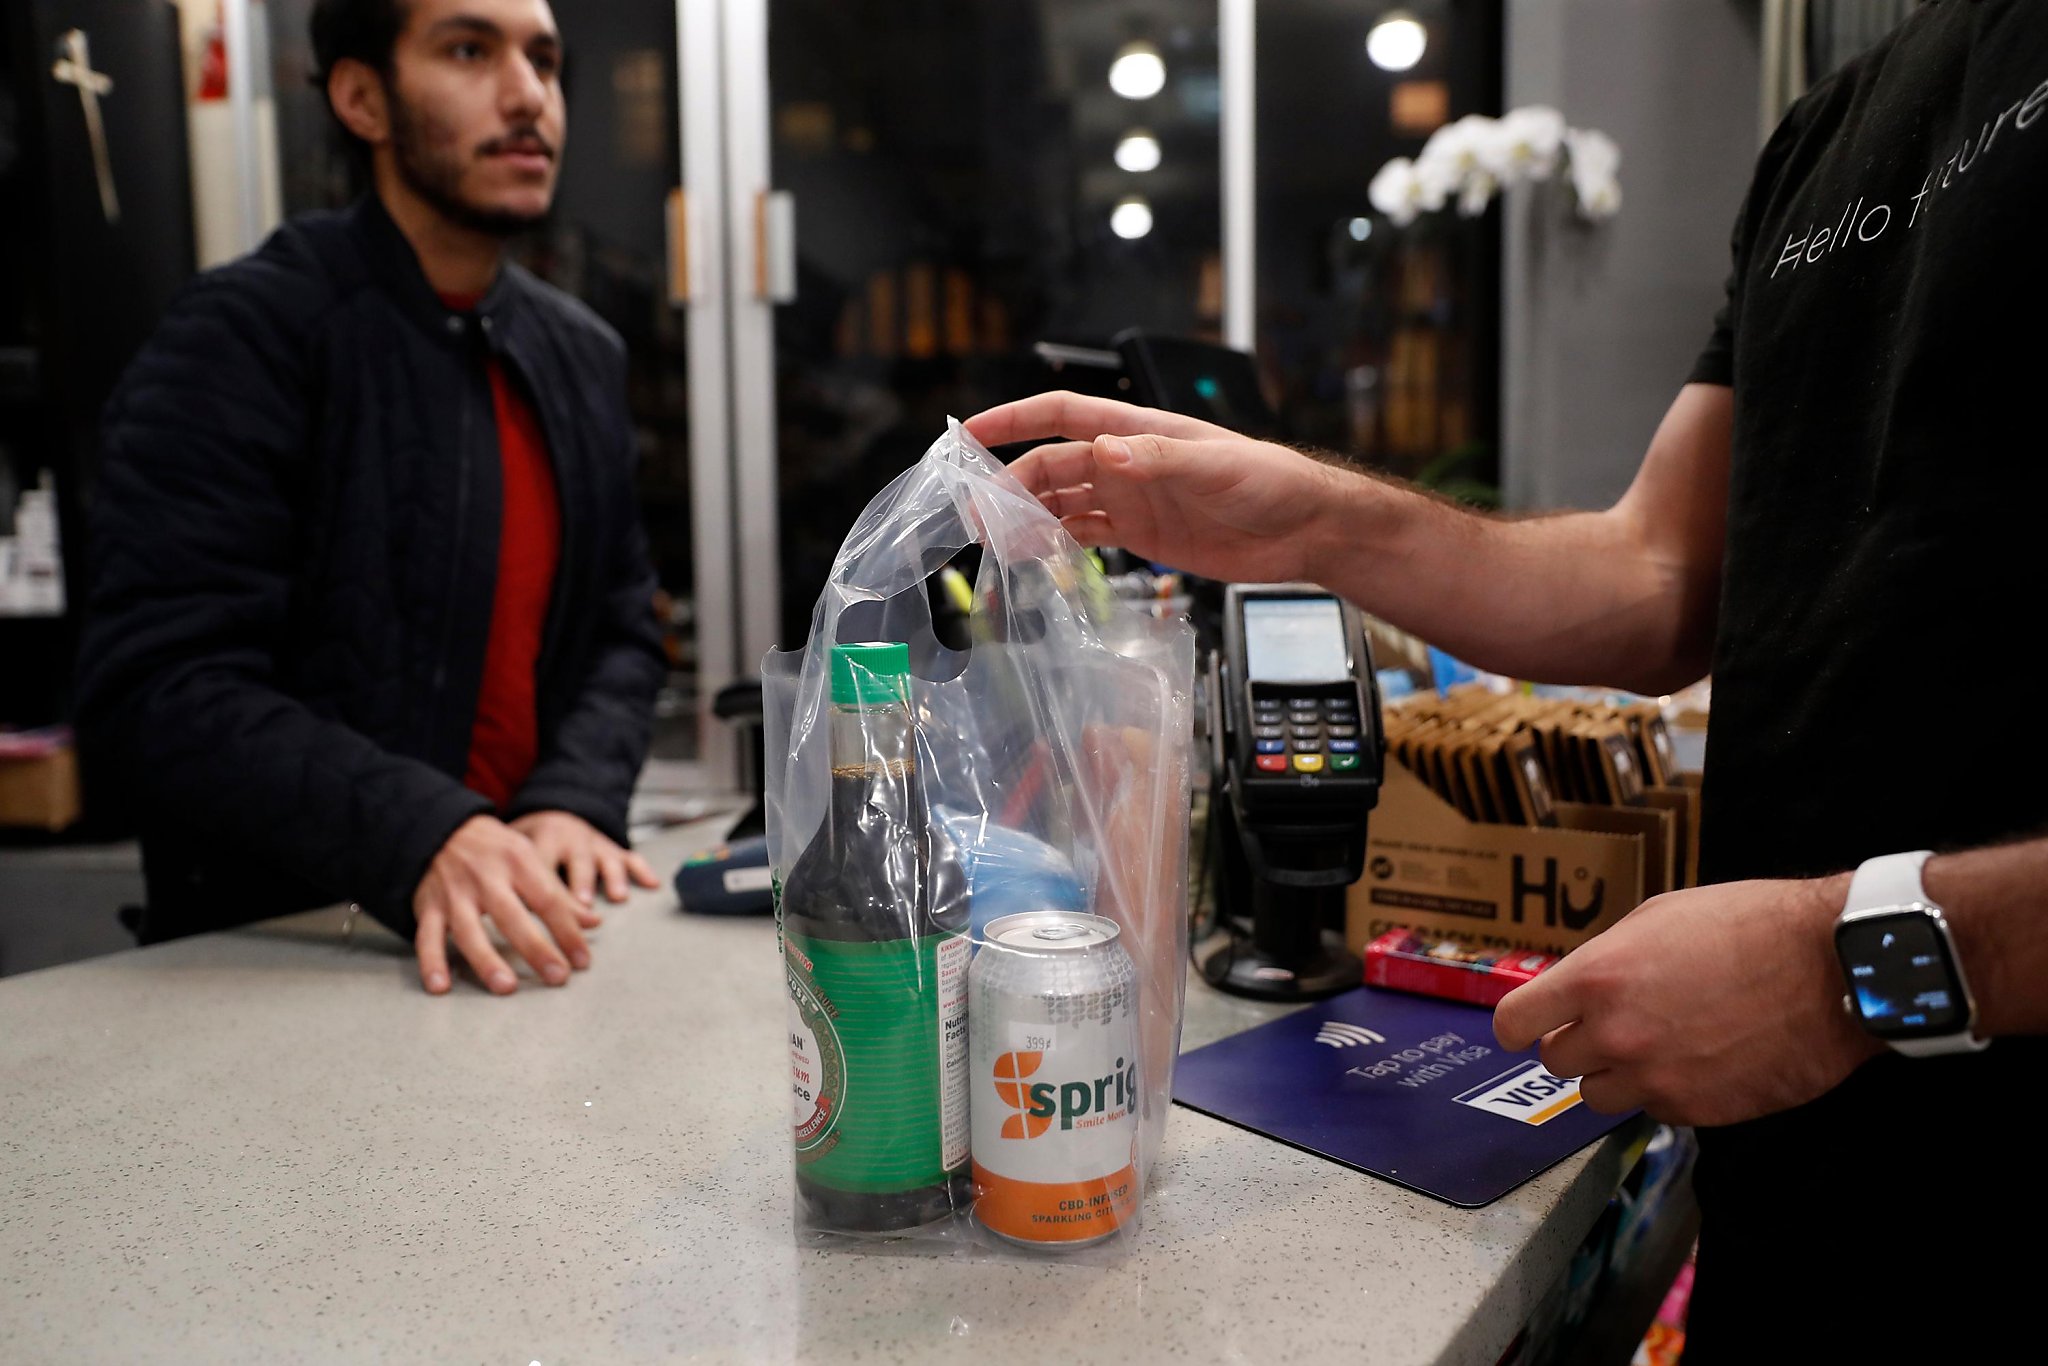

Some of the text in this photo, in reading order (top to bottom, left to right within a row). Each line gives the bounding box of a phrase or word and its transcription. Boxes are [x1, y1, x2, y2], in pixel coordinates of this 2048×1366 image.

[1770, 196, 1892, 279] Hello
[945, 1026, 966, 1042] Facts
[1346, 1031, 1467, 1080] Tap to pay
[1397, 1045, 1493, 1088] with Visa
[1487, 1074, 1577, 1108] VISA
[1031, 1211, 1092, 1224] SPARKLING
